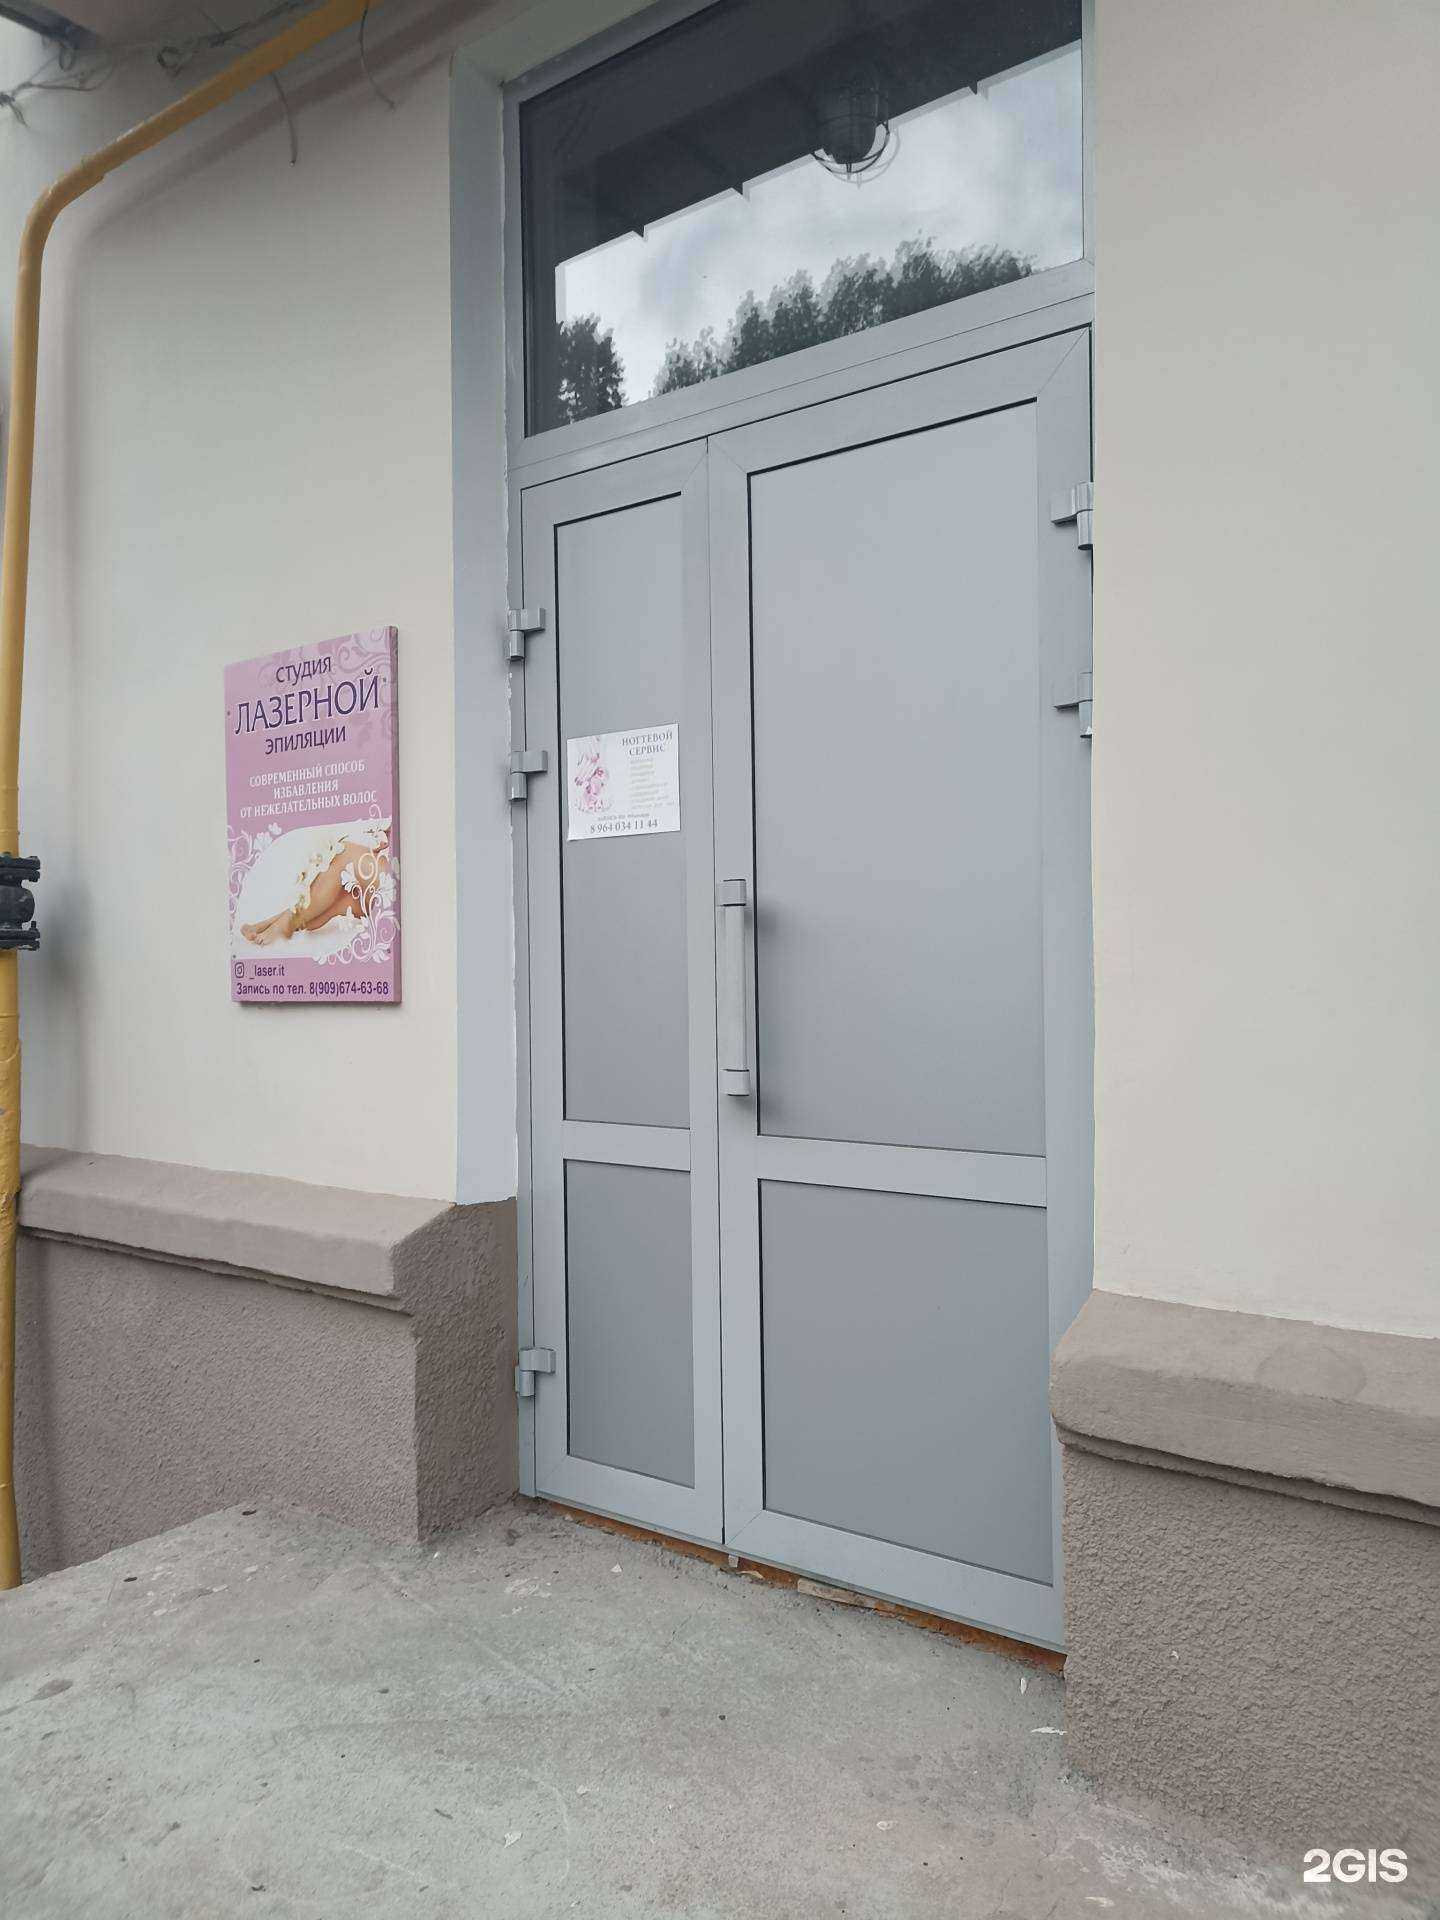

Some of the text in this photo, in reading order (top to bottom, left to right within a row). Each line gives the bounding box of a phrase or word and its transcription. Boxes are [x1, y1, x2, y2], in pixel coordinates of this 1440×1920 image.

[234, 667, 380, 735] ЛАЗЕРНОЙ
[621, 731, 674, 747] НОГТЕВОЙ
[629, 745, 666, 757] СЕРВИС
[249, 759, 366, 788] СОВРЕМЕННЫЙ СПОСОБ
[273, 779, 339, 800] ИЗБАВЛЕНИЯ
[240, 789, 378, 819] ОТ НЕЖЕЛАТЕЛЬНЫХ ВОЛОС
[236, 981, 389, 997] Запись по тел. 8(909)674-63-68
